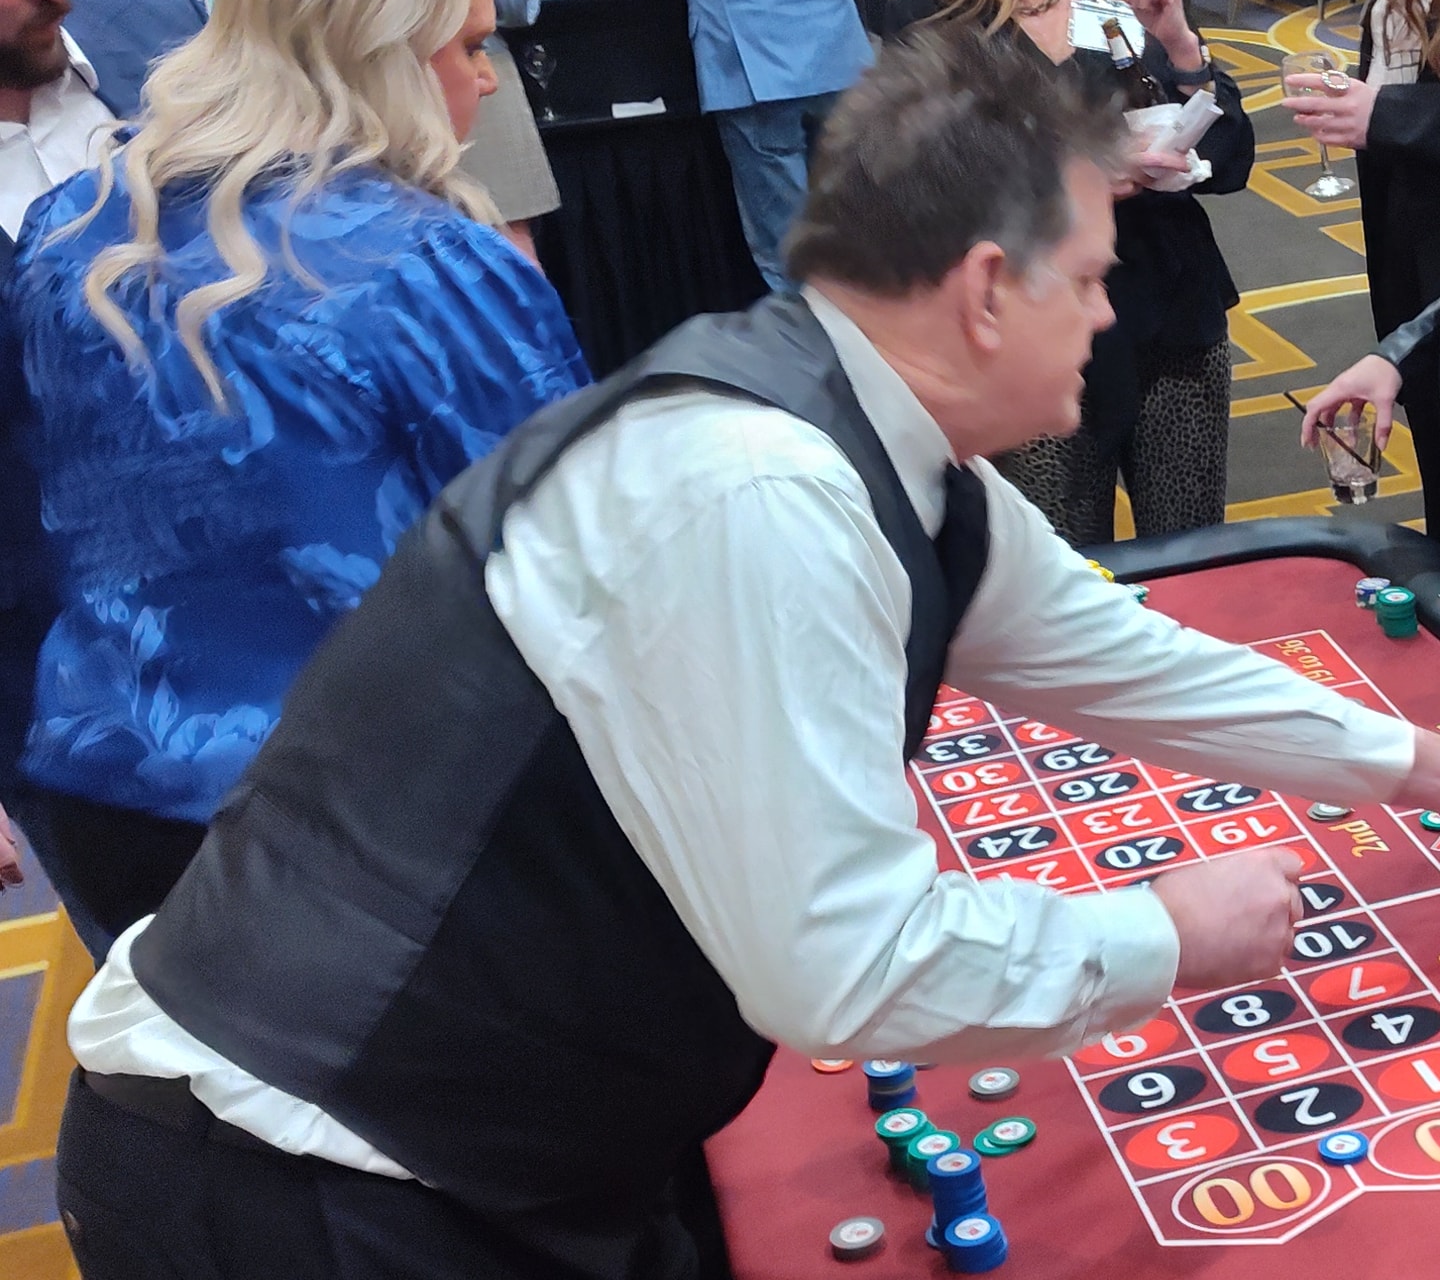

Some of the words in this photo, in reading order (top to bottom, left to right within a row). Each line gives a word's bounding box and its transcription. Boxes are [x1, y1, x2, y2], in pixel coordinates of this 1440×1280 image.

[1274, 639, 1313, 657] 36
[1297, 655, 1324, 669] to
[1021, 721, 1060, 741] 2
[924, 734, 991, 762] 33
[1042, 742, 1111, 772] 29
[942, 763, 1010, 793] 30
[1058, 771, 1131, 803] 26
[963, 792, 1031, 825] 27
[1183, 783, 1256, 812] 22
[1082, 803, 1153, 835] 23
[1210, 815, 1278, 845] 19
[977, 825, 1050, 858] 24
[1104, 835, 1177, 869] 20
[1328, 819, 1391, 858] 2nd
[1293, 923, 1368, 958] 10
[1348, 966, 1387, 1001] 7
[1221, 994, 1271, 1028] 8
[1370, 1011, 1416, 1045] 4
[1252, 1039, 1301, 1076] 5
[1127, 1071, 1177, 1109] 6
[1280, 1087, 1337, 1126] 2
[1156, 1120, 1207, 1160] 3
[1192, 1162, 1312, 1226] 00
